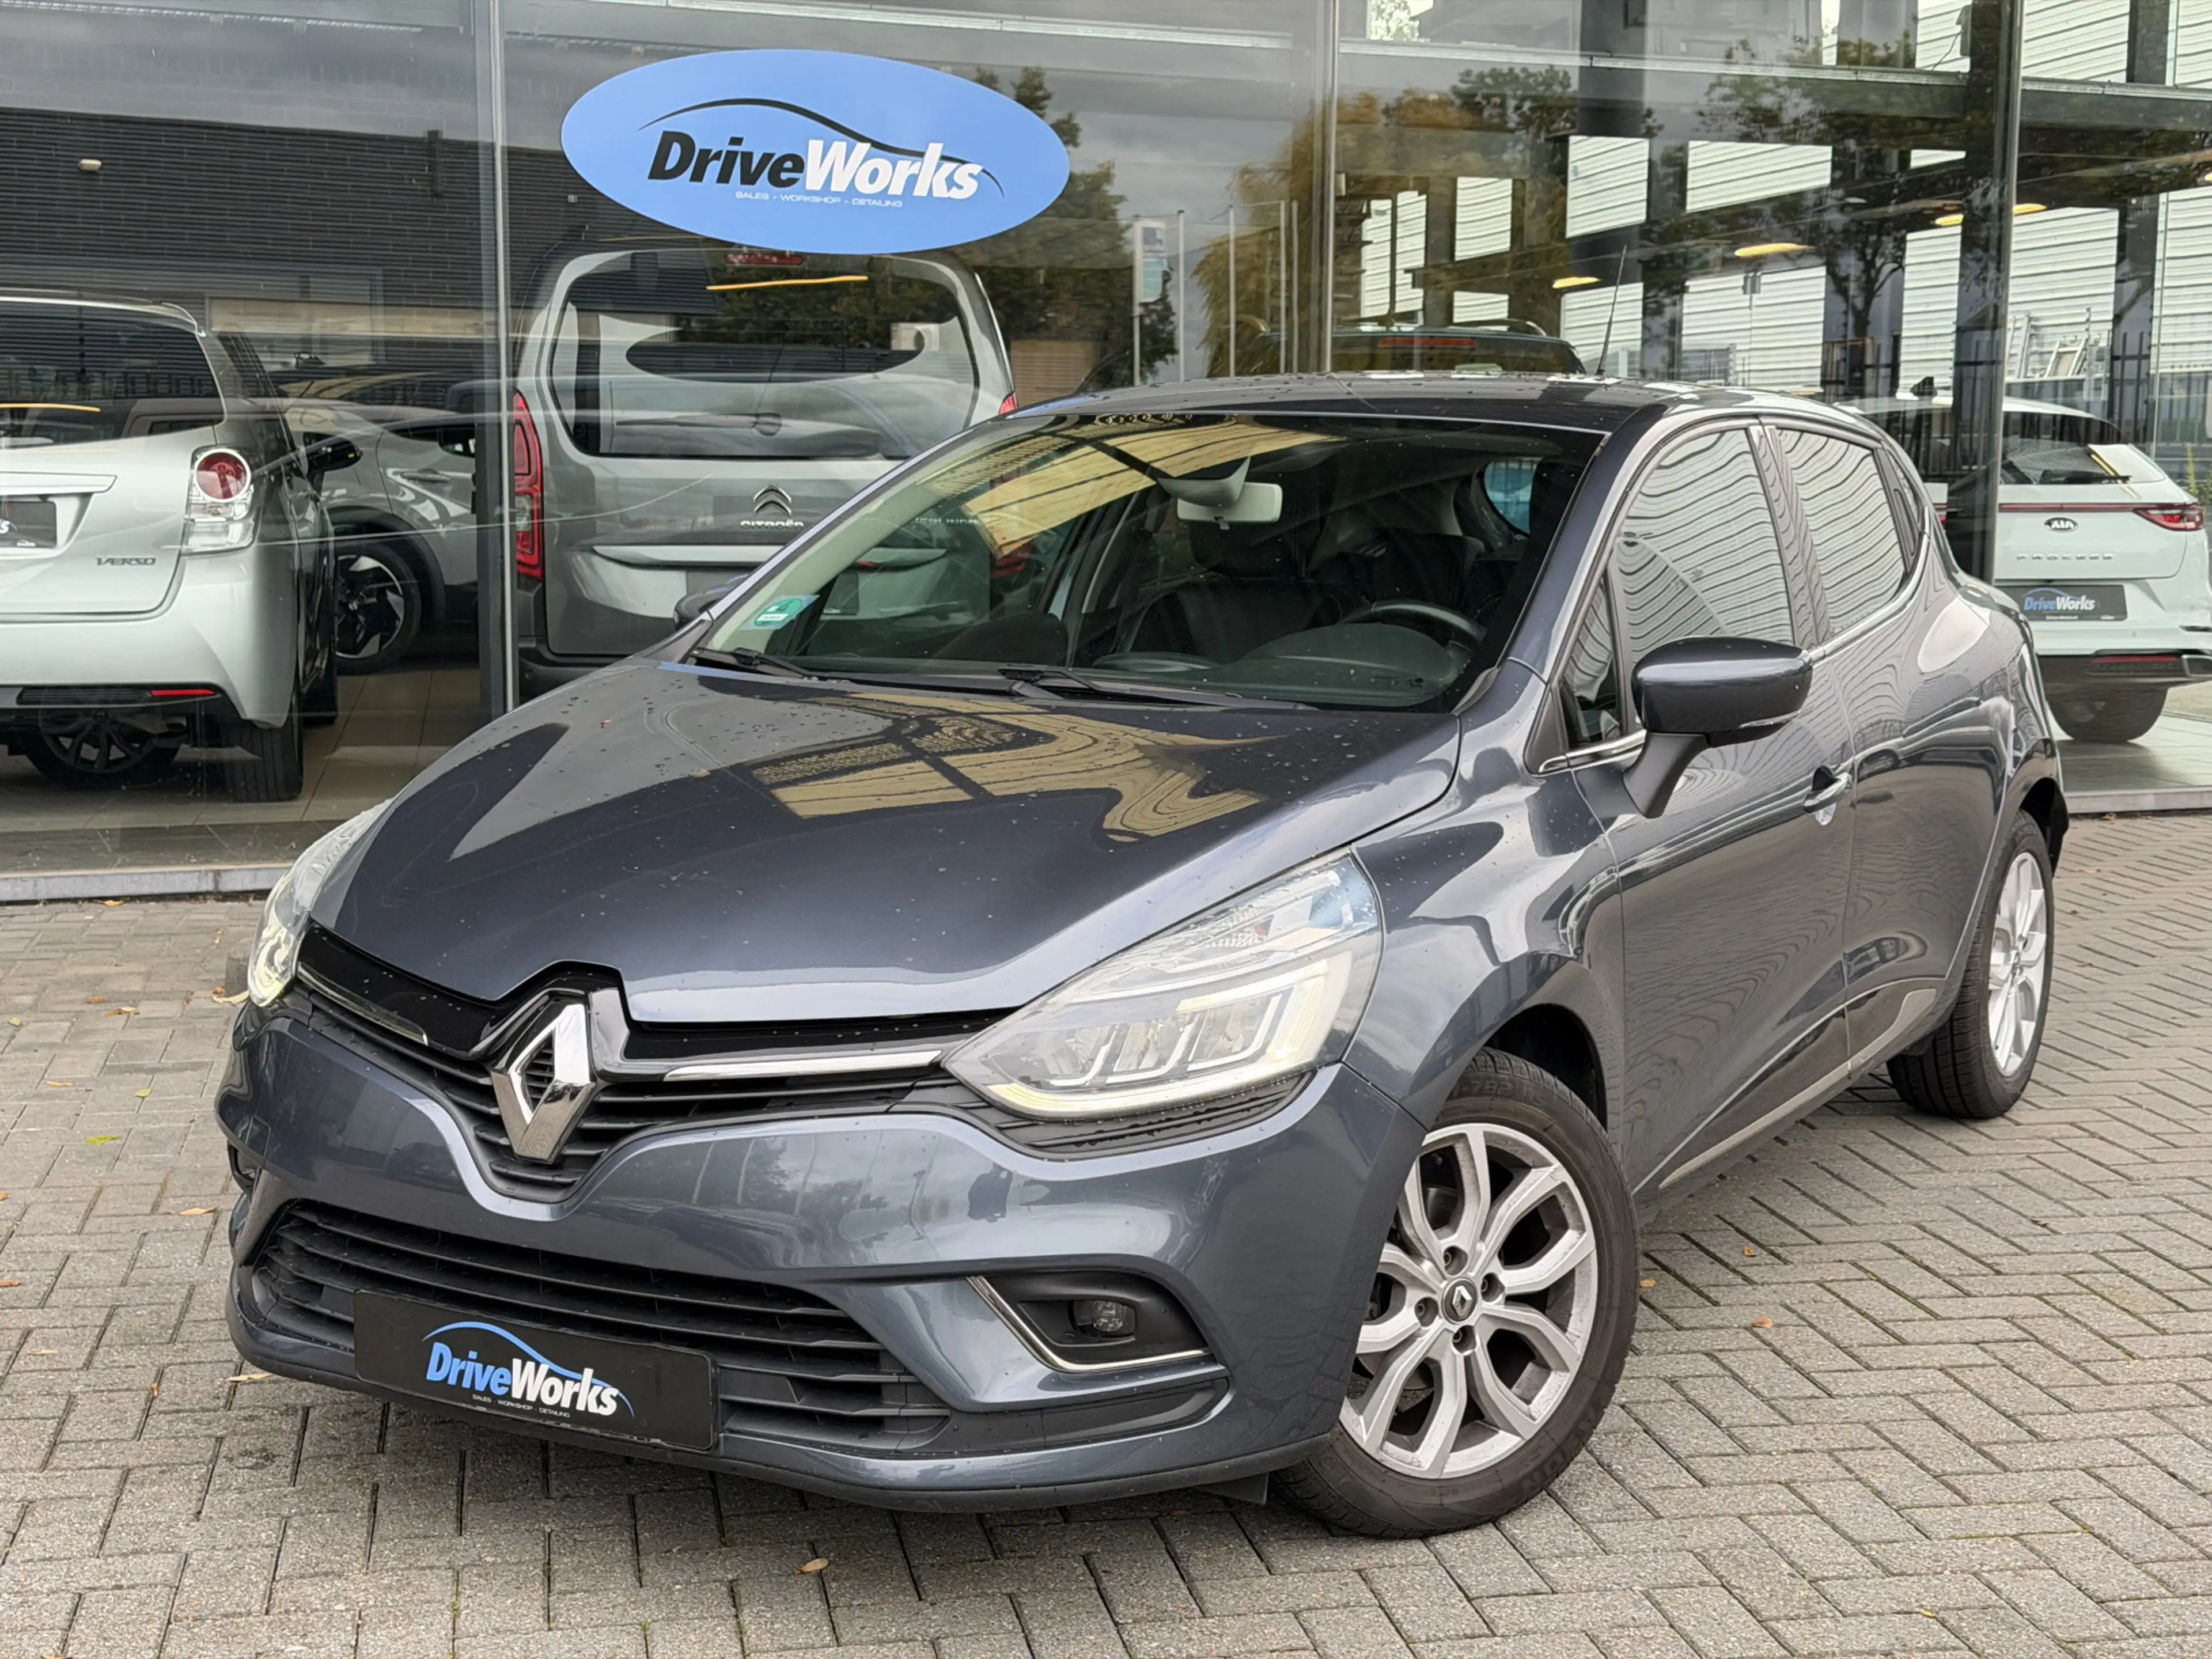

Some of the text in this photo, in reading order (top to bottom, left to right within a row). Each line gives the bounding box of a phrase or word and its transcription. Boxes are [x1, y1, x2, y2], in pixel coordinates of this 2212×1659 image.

[647, 130, 983, 199] DriveWorks
[735, 191, 903, 208] SALES WORKSHOP DETAILING
[96, 556, 157, 567] VERSO
[2024, 594, 2095, 611] DriveWorks
[426, 1342, 620, 1416] DriveWorks
[472, 1393, 571, 1418] SALES WORKSHOP DETAILING
